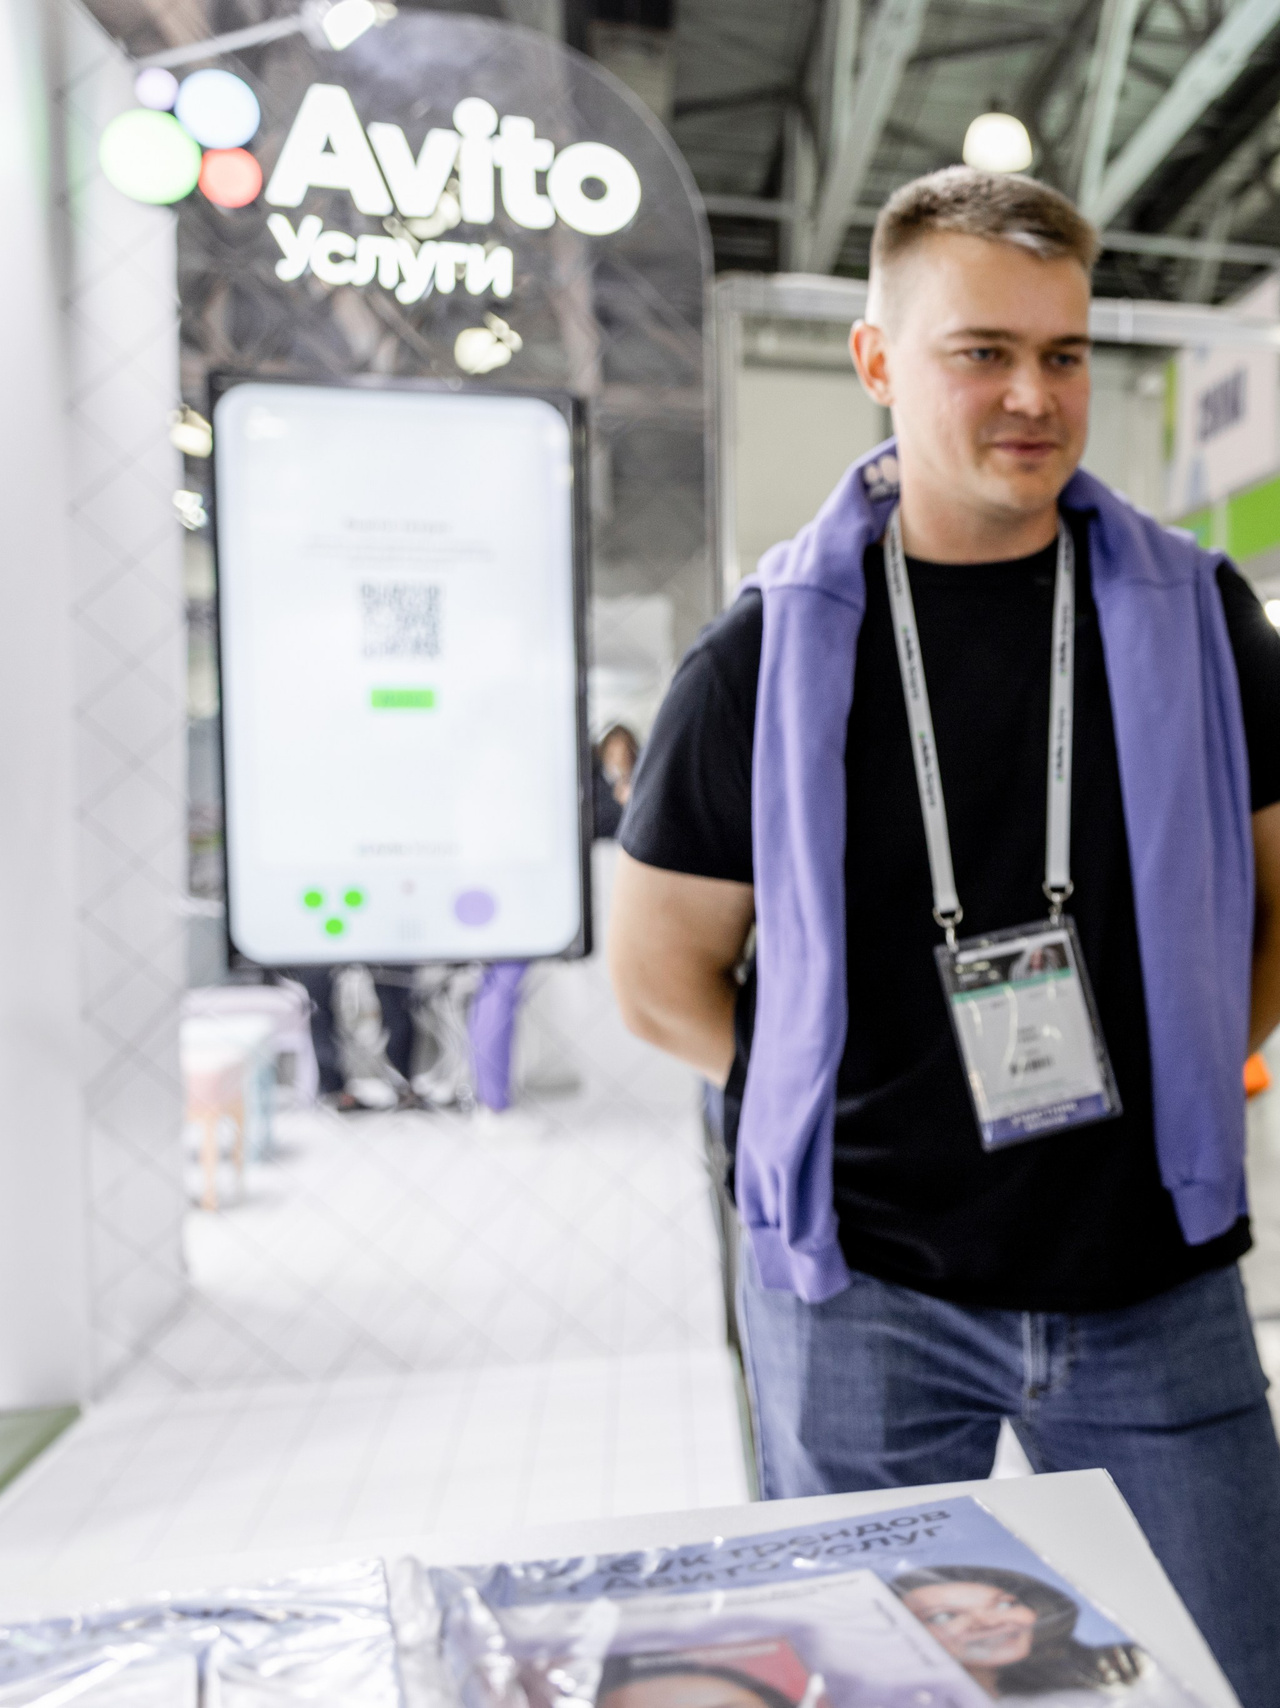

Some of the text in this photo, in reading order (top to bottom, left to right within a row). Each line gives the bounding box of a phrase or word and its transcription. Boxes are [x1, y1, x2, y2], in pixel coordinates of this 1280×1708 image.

[265, 83, 641, 236] Avito
[266, 213, 514, 305] Услуги
[731, 1511, 951, 1559] трендов
